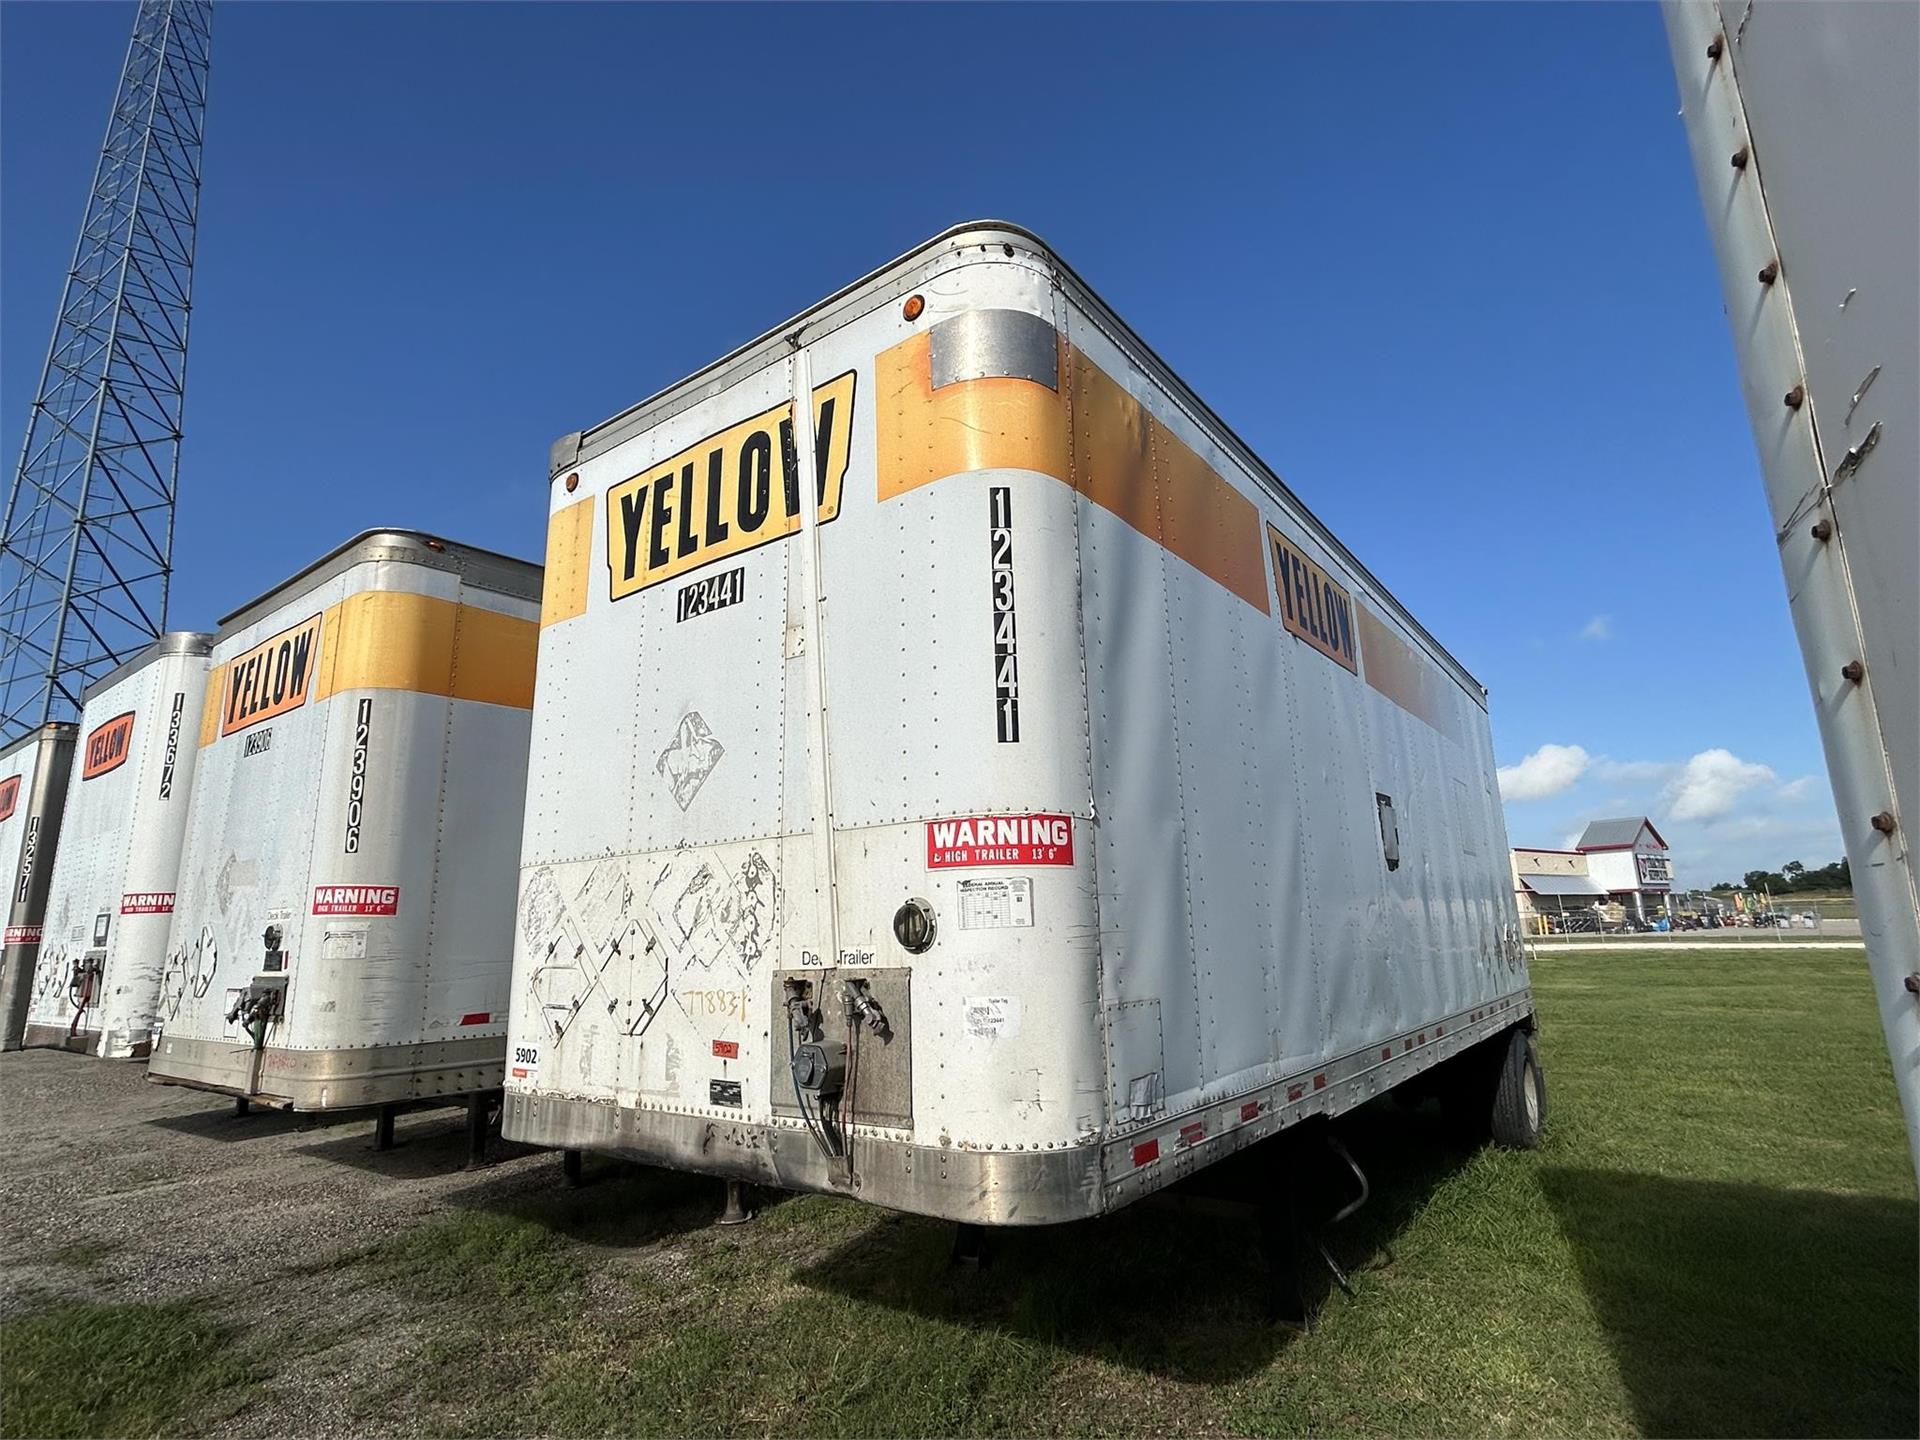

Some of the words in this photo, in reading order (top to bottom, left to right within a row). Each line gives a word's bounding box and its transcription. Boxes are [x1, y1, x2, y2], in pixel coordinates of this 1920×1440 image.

[621, 397, 836, 582] YELLOW
[679, 568, 743, 621] 123441
[992, 488, 1018, 742] 123441
[1275, 540, 1353, 662] YELLOW
[228, 627, 314, 724] YELLOW
[88, 721, 128, 770] YELLOW
[160, 694, 183, 800] 133672
[346, 701, 370, 853] 123906
[18, 817, 40, 902] 132571
[933, 819, 1069, 849] WARNING
[945, 850, 968, 862] HIGH
[975, 848, 1019, 861] TRAILER
[1032, 848, 1045, 860] 13'
[123, 895, 175, 906] WARNIN
[316, 889, 396, 904] WARNING
[840, 949, 874, 965] Trailer
[515, 1047, 537, 1064] 5902
